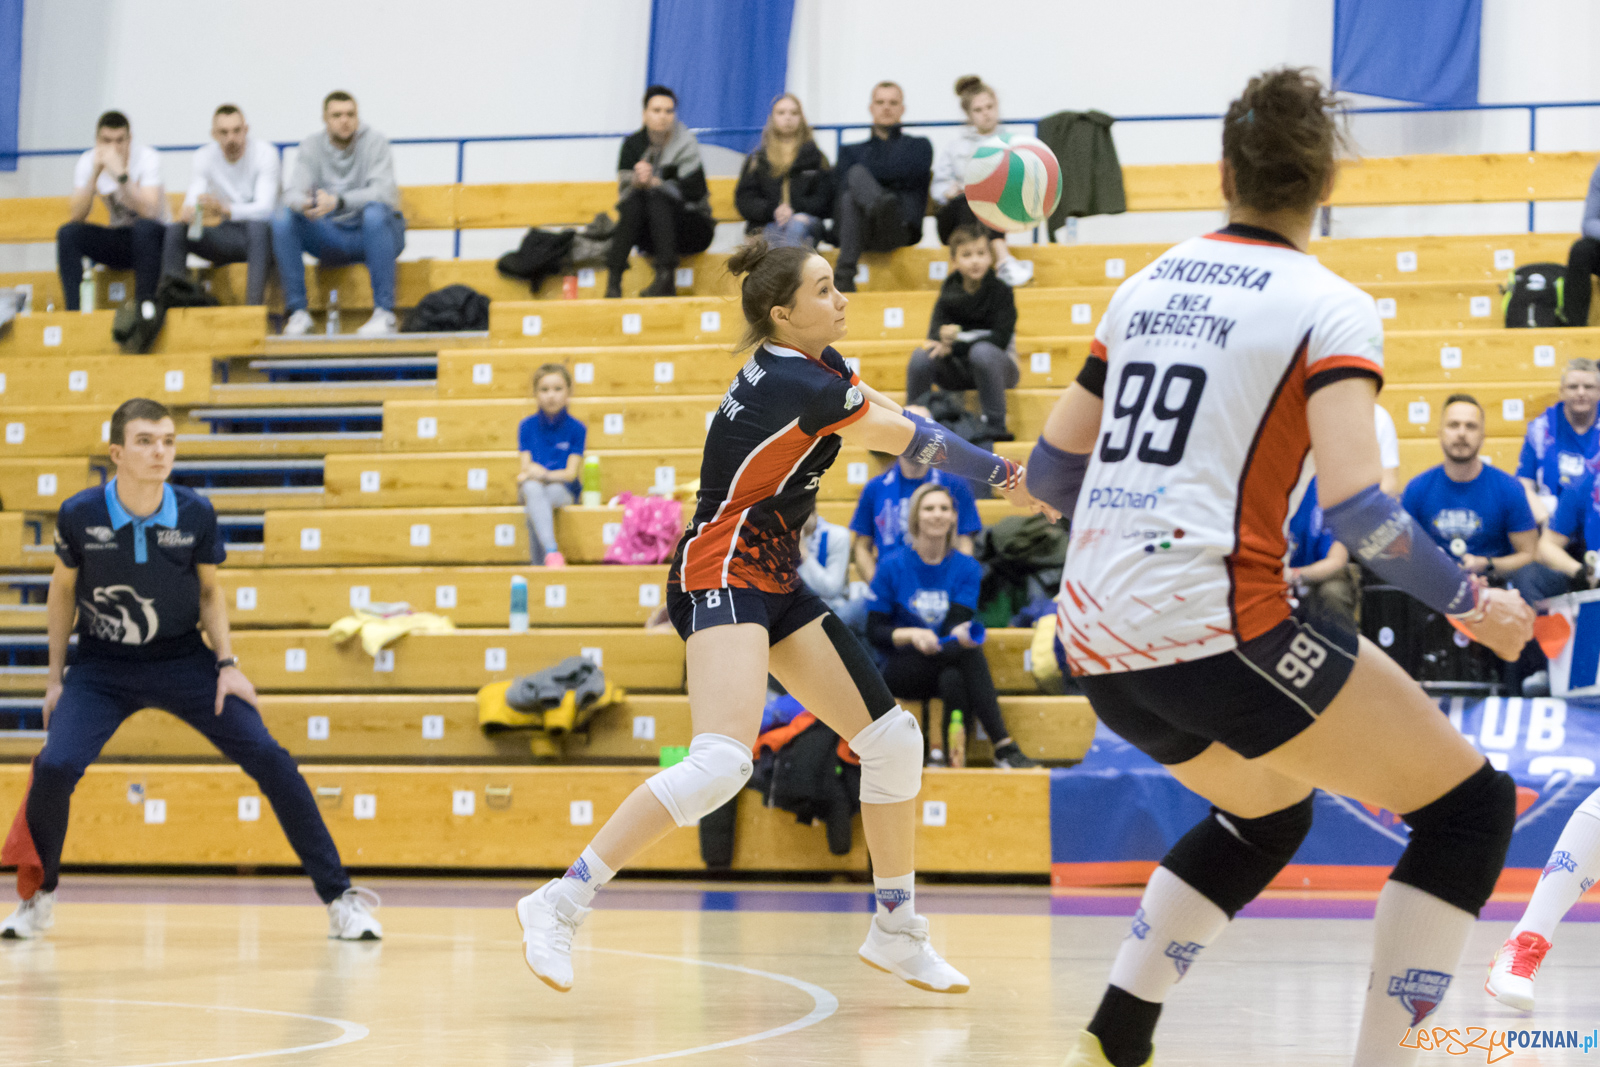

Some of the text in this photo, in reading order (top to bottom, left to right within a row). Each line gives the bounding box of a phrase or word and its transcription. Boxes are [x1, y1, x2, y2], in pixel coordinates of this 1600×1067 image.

[1149, 258, 1273, 291] SIKORSKA
[1166, 293, 1212, 312] ENEA
[1125, 311, 1237, 349] ENERGETYK
[1100, 362, 1207, 467] 99
[706, 589, 721, 609] 8
[1276, 632, 1328, 688] 99
